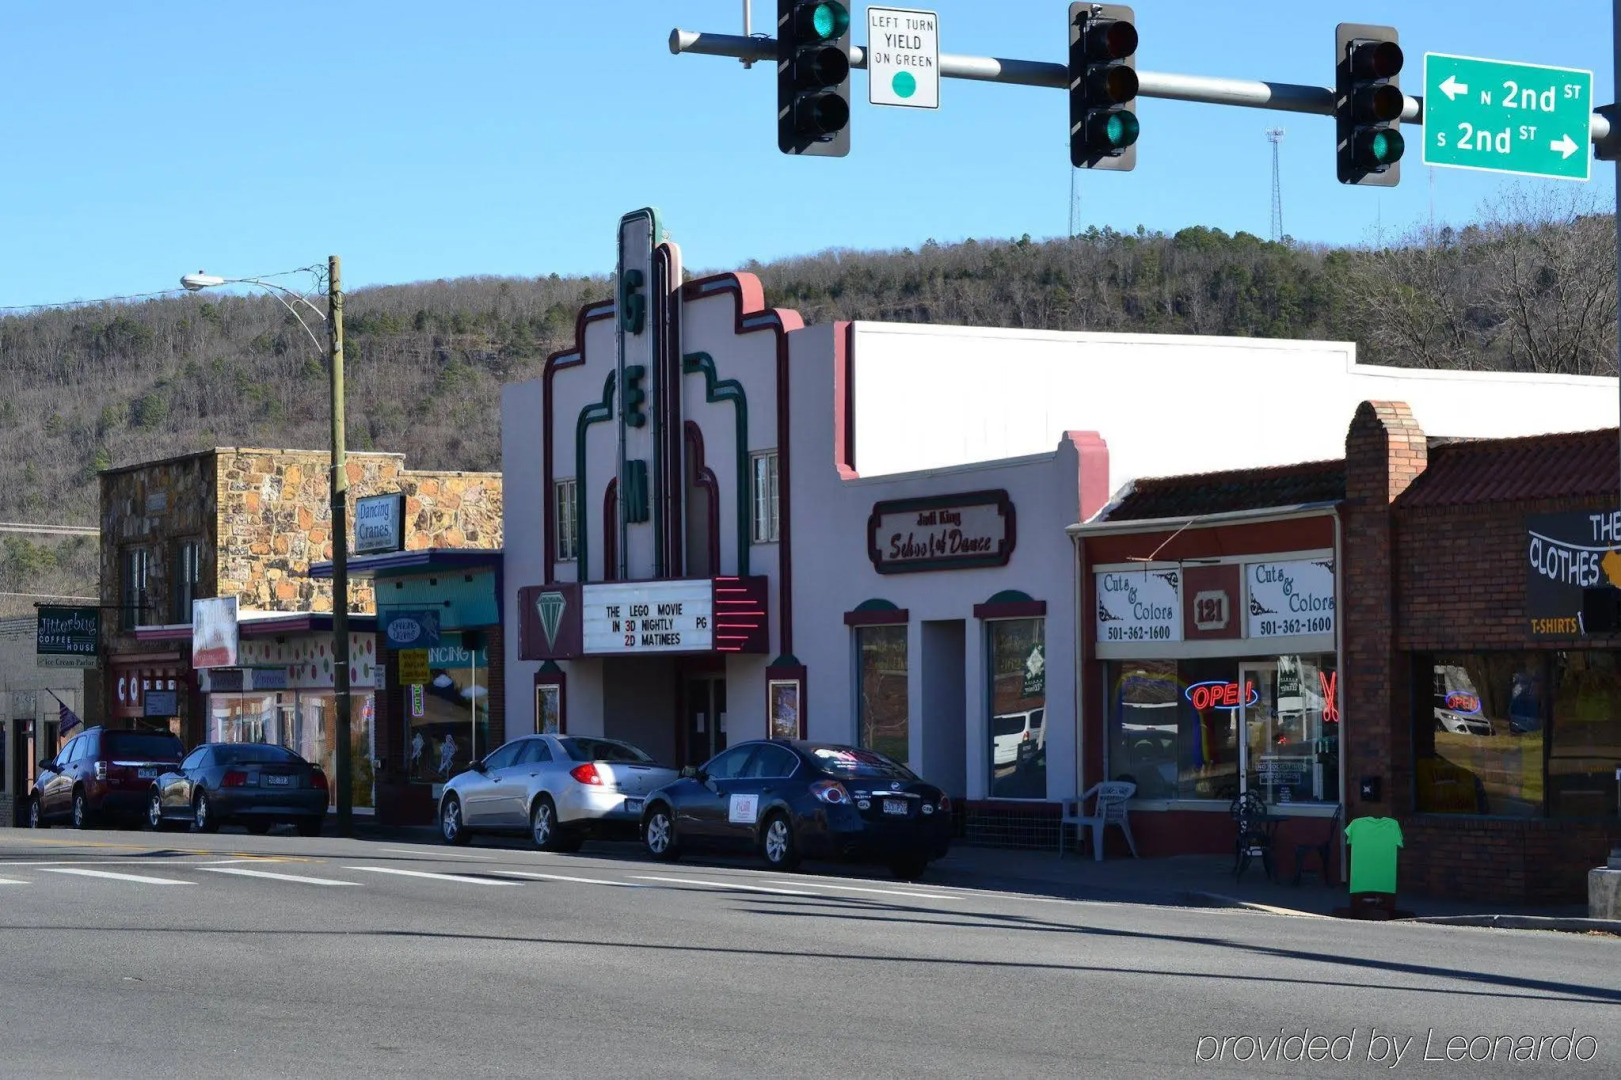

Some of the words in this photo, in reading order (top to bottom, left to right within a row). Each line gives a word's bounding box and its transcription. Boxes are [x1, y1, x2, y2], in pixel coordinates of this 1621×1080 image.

[872, 16, 898, 28] LEFT
[906, 19, 933, 31] TURN
[885, 33, 921, 50] YIELD
[875, 52, 890, 64] ON
[896, 54, 932, 67] GREEN
[1480, 90, 1492, 106] N
[1502, 80, 1556, 112] 2nd
[1563, 84, 1582, 99] ST
[1436, 132, 1446, 147] S
[1457, 122, 1511, 154] 2nd
[1519, 126, 1537, 140] ST
[622, 268, 648, 524] GEM
[360, 501, 389, 521] Dancing
[939, 510, 961, 526] King
[359, 524, 389, 540] Cranes
[1589, 511, 1621, 541] THE
[889, 532, 935, 558] School
[935, 529, 947, 554] of
[948, 528, 992, 554] Dance
[1529, 537, 1600, 587] CLOTHES
[1104, 573, 1129, 592] Cuts
[1255, 565, 1284, 584] Cuts
[606, 606, 620, 618] THE
[629, 605, 649, 617] LEGO
[657, 603, 682, 616] MOVIE
[1197, 598, 1224, 623] 121
[1289, 592, 1334, 613] Colors
[1133, 602, 1173, 621] Colors
[39, 612, 97, 636] Jitterbug
[612, 621, 620, 632] IN
[625, 621, 636, 632] 3D
[641, 619, 673, 632] NIGHTLY
[696, 617, 707, 629] PG
[1260, 616, 1331, 635] 501-362-1600
[1531, 618, 1577, 634] T-SHIRTS
[39, 635, 71, 643] COFFEE
[624, 635, 636, 646] 2D
[641, 633, 681, 646] MATINEES
[1107, 625, 1170, 640] 501-362-1600
[66, 644, 95, 652] HOUSE
[55, 658, 74, 666] Cream
[1448, 696, 1478, 711] OPEN
